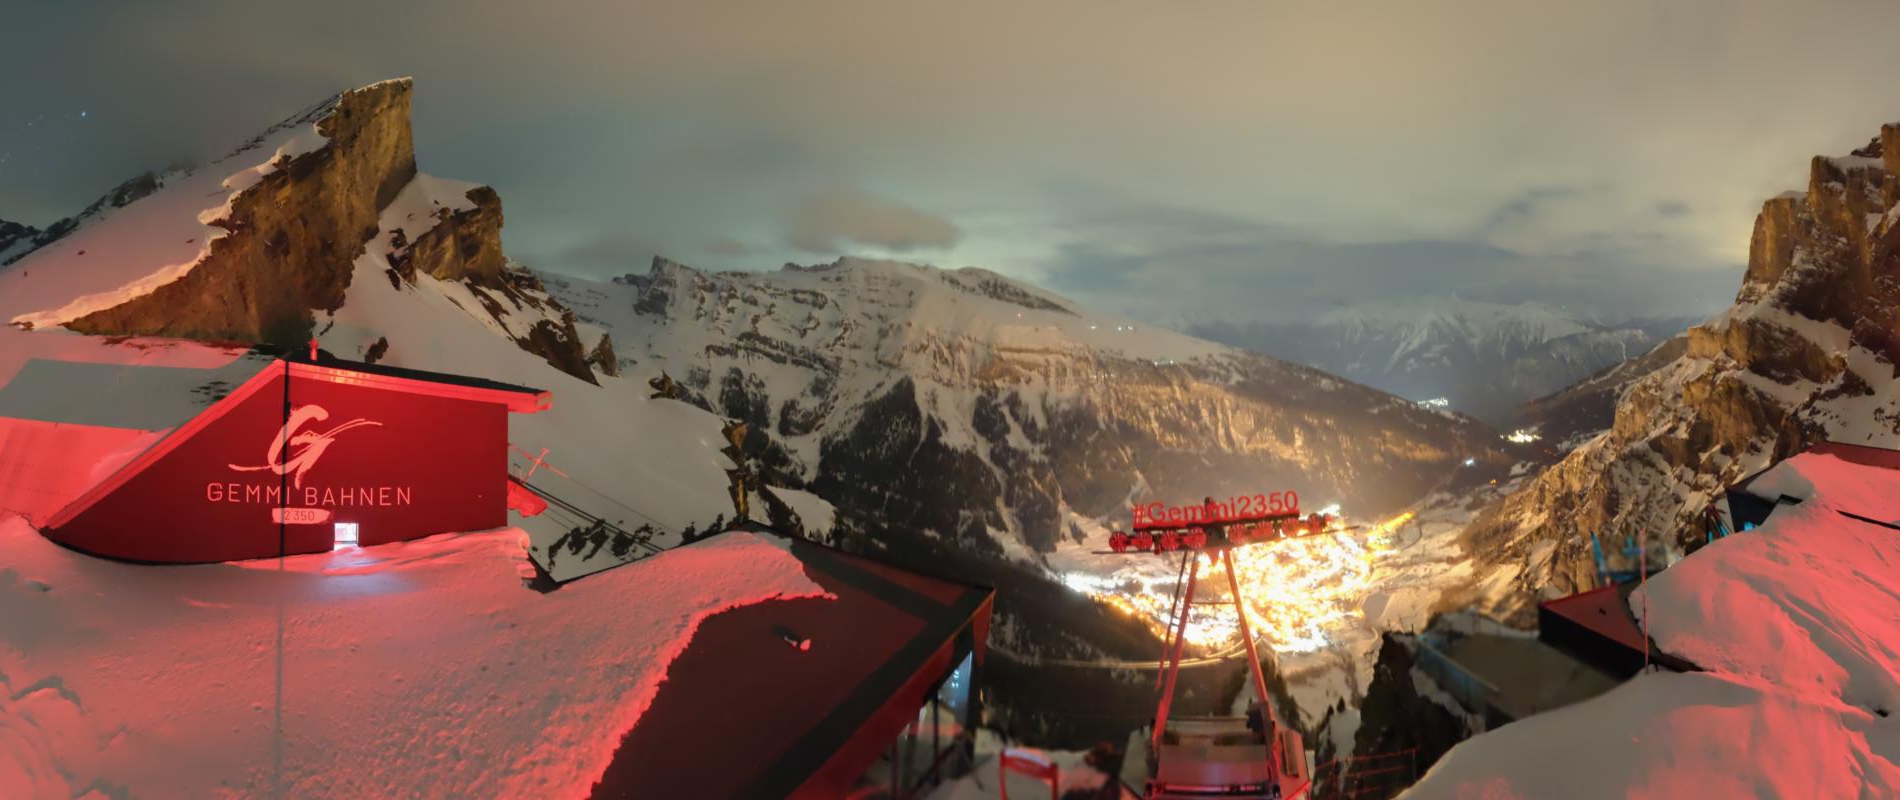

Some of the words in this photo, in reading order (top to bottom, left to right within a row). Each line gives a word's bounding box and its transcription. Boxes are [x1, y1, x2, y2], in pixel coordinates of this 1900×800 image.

[207, 482, 290, 505] GEMMI
[305, 487, 411, 505] BAHNEN
[1133, 490, 1298, 525] #Gemmi2350
